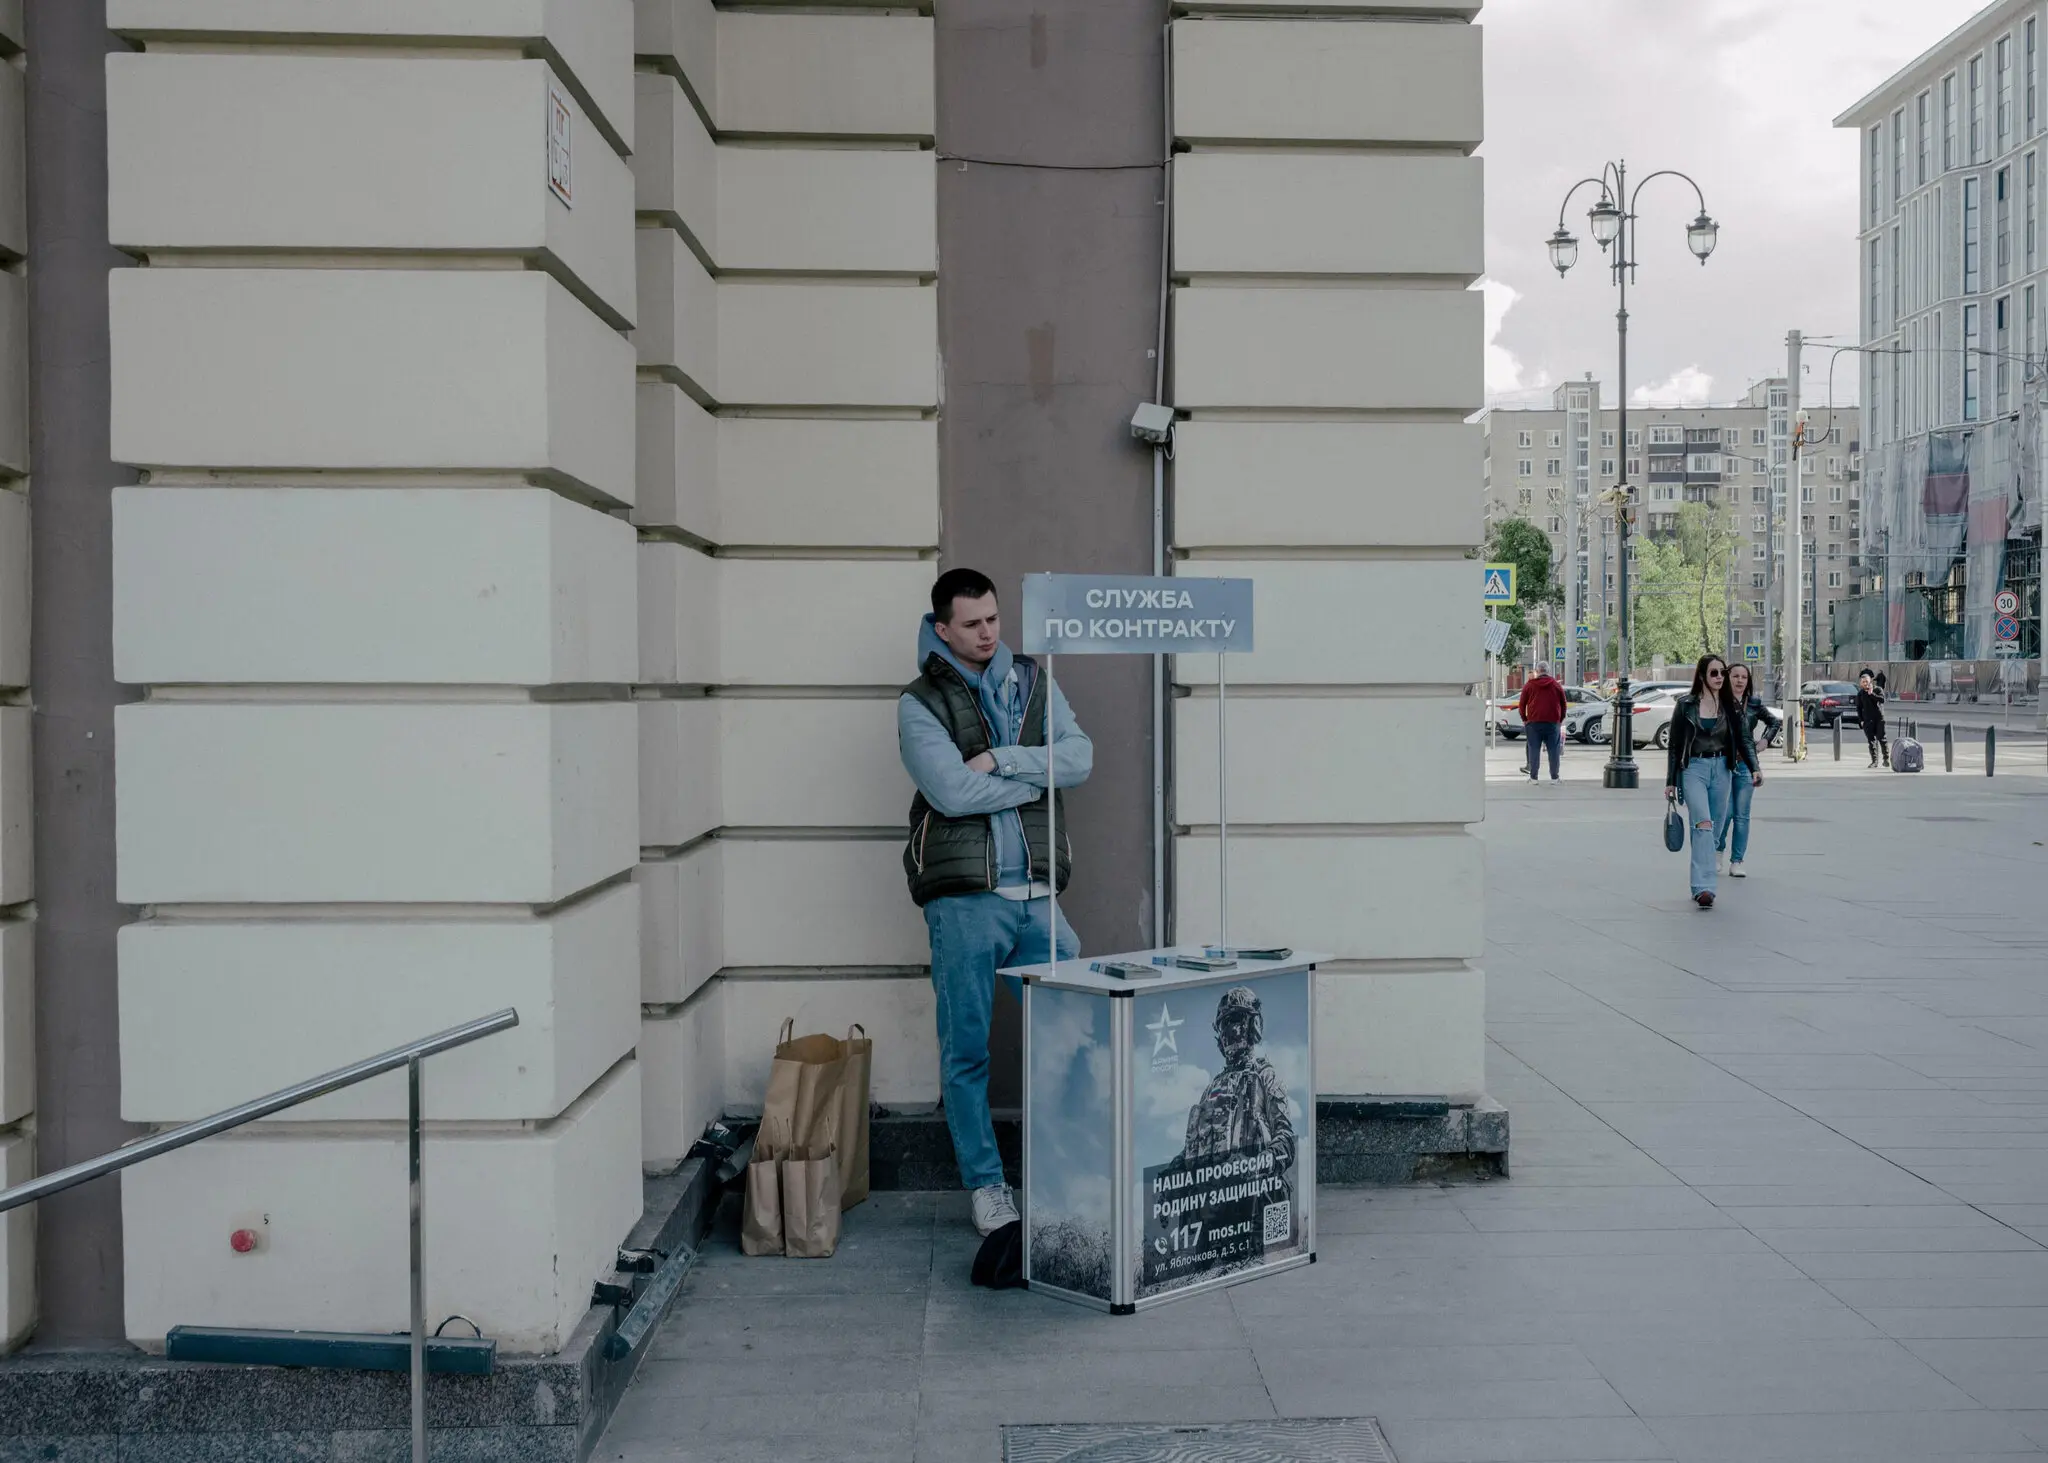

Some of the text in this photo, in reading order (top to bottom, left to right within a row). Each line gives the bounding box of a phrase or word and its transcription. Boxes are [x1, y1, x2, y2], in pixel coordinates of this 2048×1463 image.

[1085, 588, 1194, 609] СЛУЖБА
[2000, 598, 2013, 609] 30
[1045, 618, 1236, 639] ПО КОНТРАКТУ
[1153, 1171, 1194, 1194] НАША
[1196, 1153, 1273, 1184] ПРОФЕССИЯ
[1153, 1175, 1282, 1219] РОДИНУ ЗАЩИЩАТЬ
[1170, 1220, 1250, 1251] 117 mos.ru
[1155, 1262, 1168, 1276] ул.
